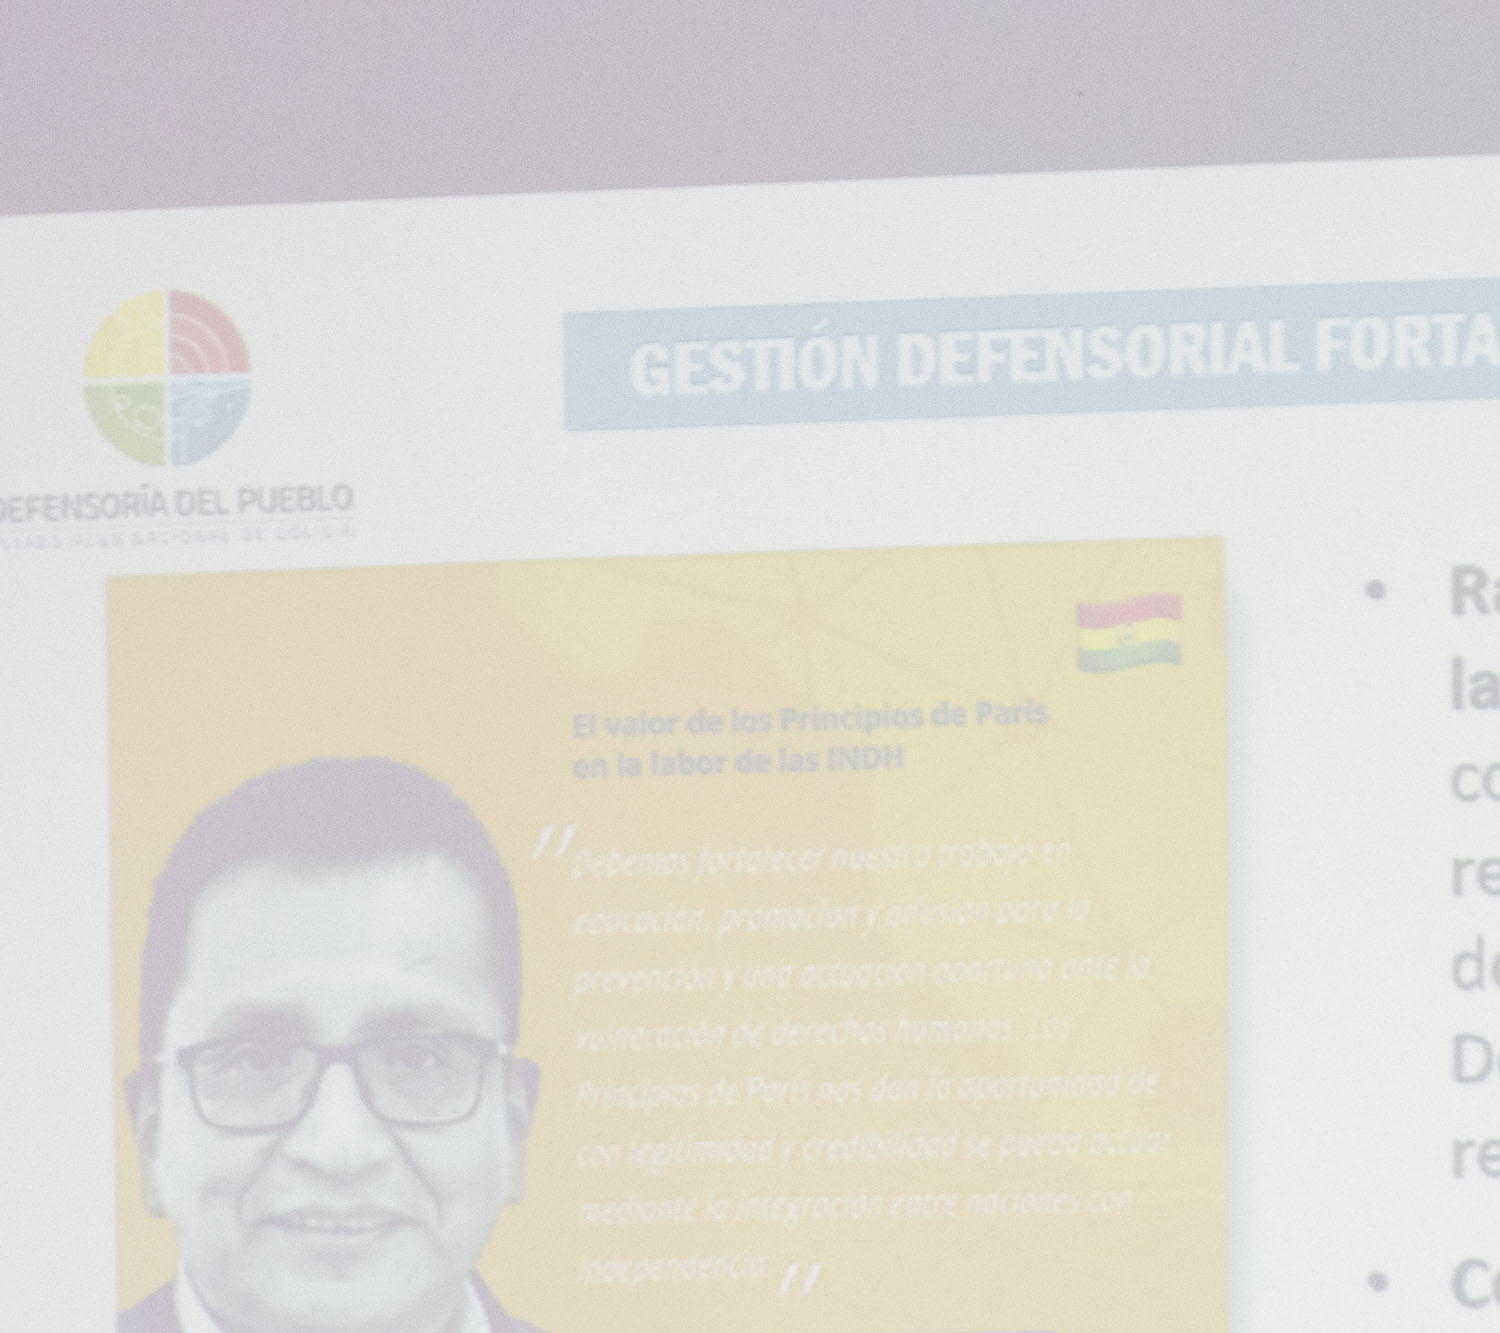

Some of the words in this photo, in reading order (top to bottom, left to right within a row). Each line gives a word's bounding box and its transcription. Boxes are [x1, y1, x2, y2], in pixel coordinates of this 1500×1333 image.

[631, 320, 876, 396] GESTIÓN
[899, 321, 1298, 384] DEFENSORIAL
[176, 488, 229, 516] DEL
[238, 482, 355, 513] PUEBLO
[573, 712, 596, 738] El
[604, 711, 679, 735] valor
[687, 707, 723, 733] de
[731, 708, 771, 732] los
[781, 703, 925, 732] Principios
[930, 700, 967, 727] de
[976, 697, 1052, 727] París
[573, 758, 608, 779] en
[617, 754, 642, 778] la
[651, 753, 726, 777] labor
[734, 749, 770, 774] de
[778, 749, 819, 773] las
[828, 746, 904, 771] INDH
